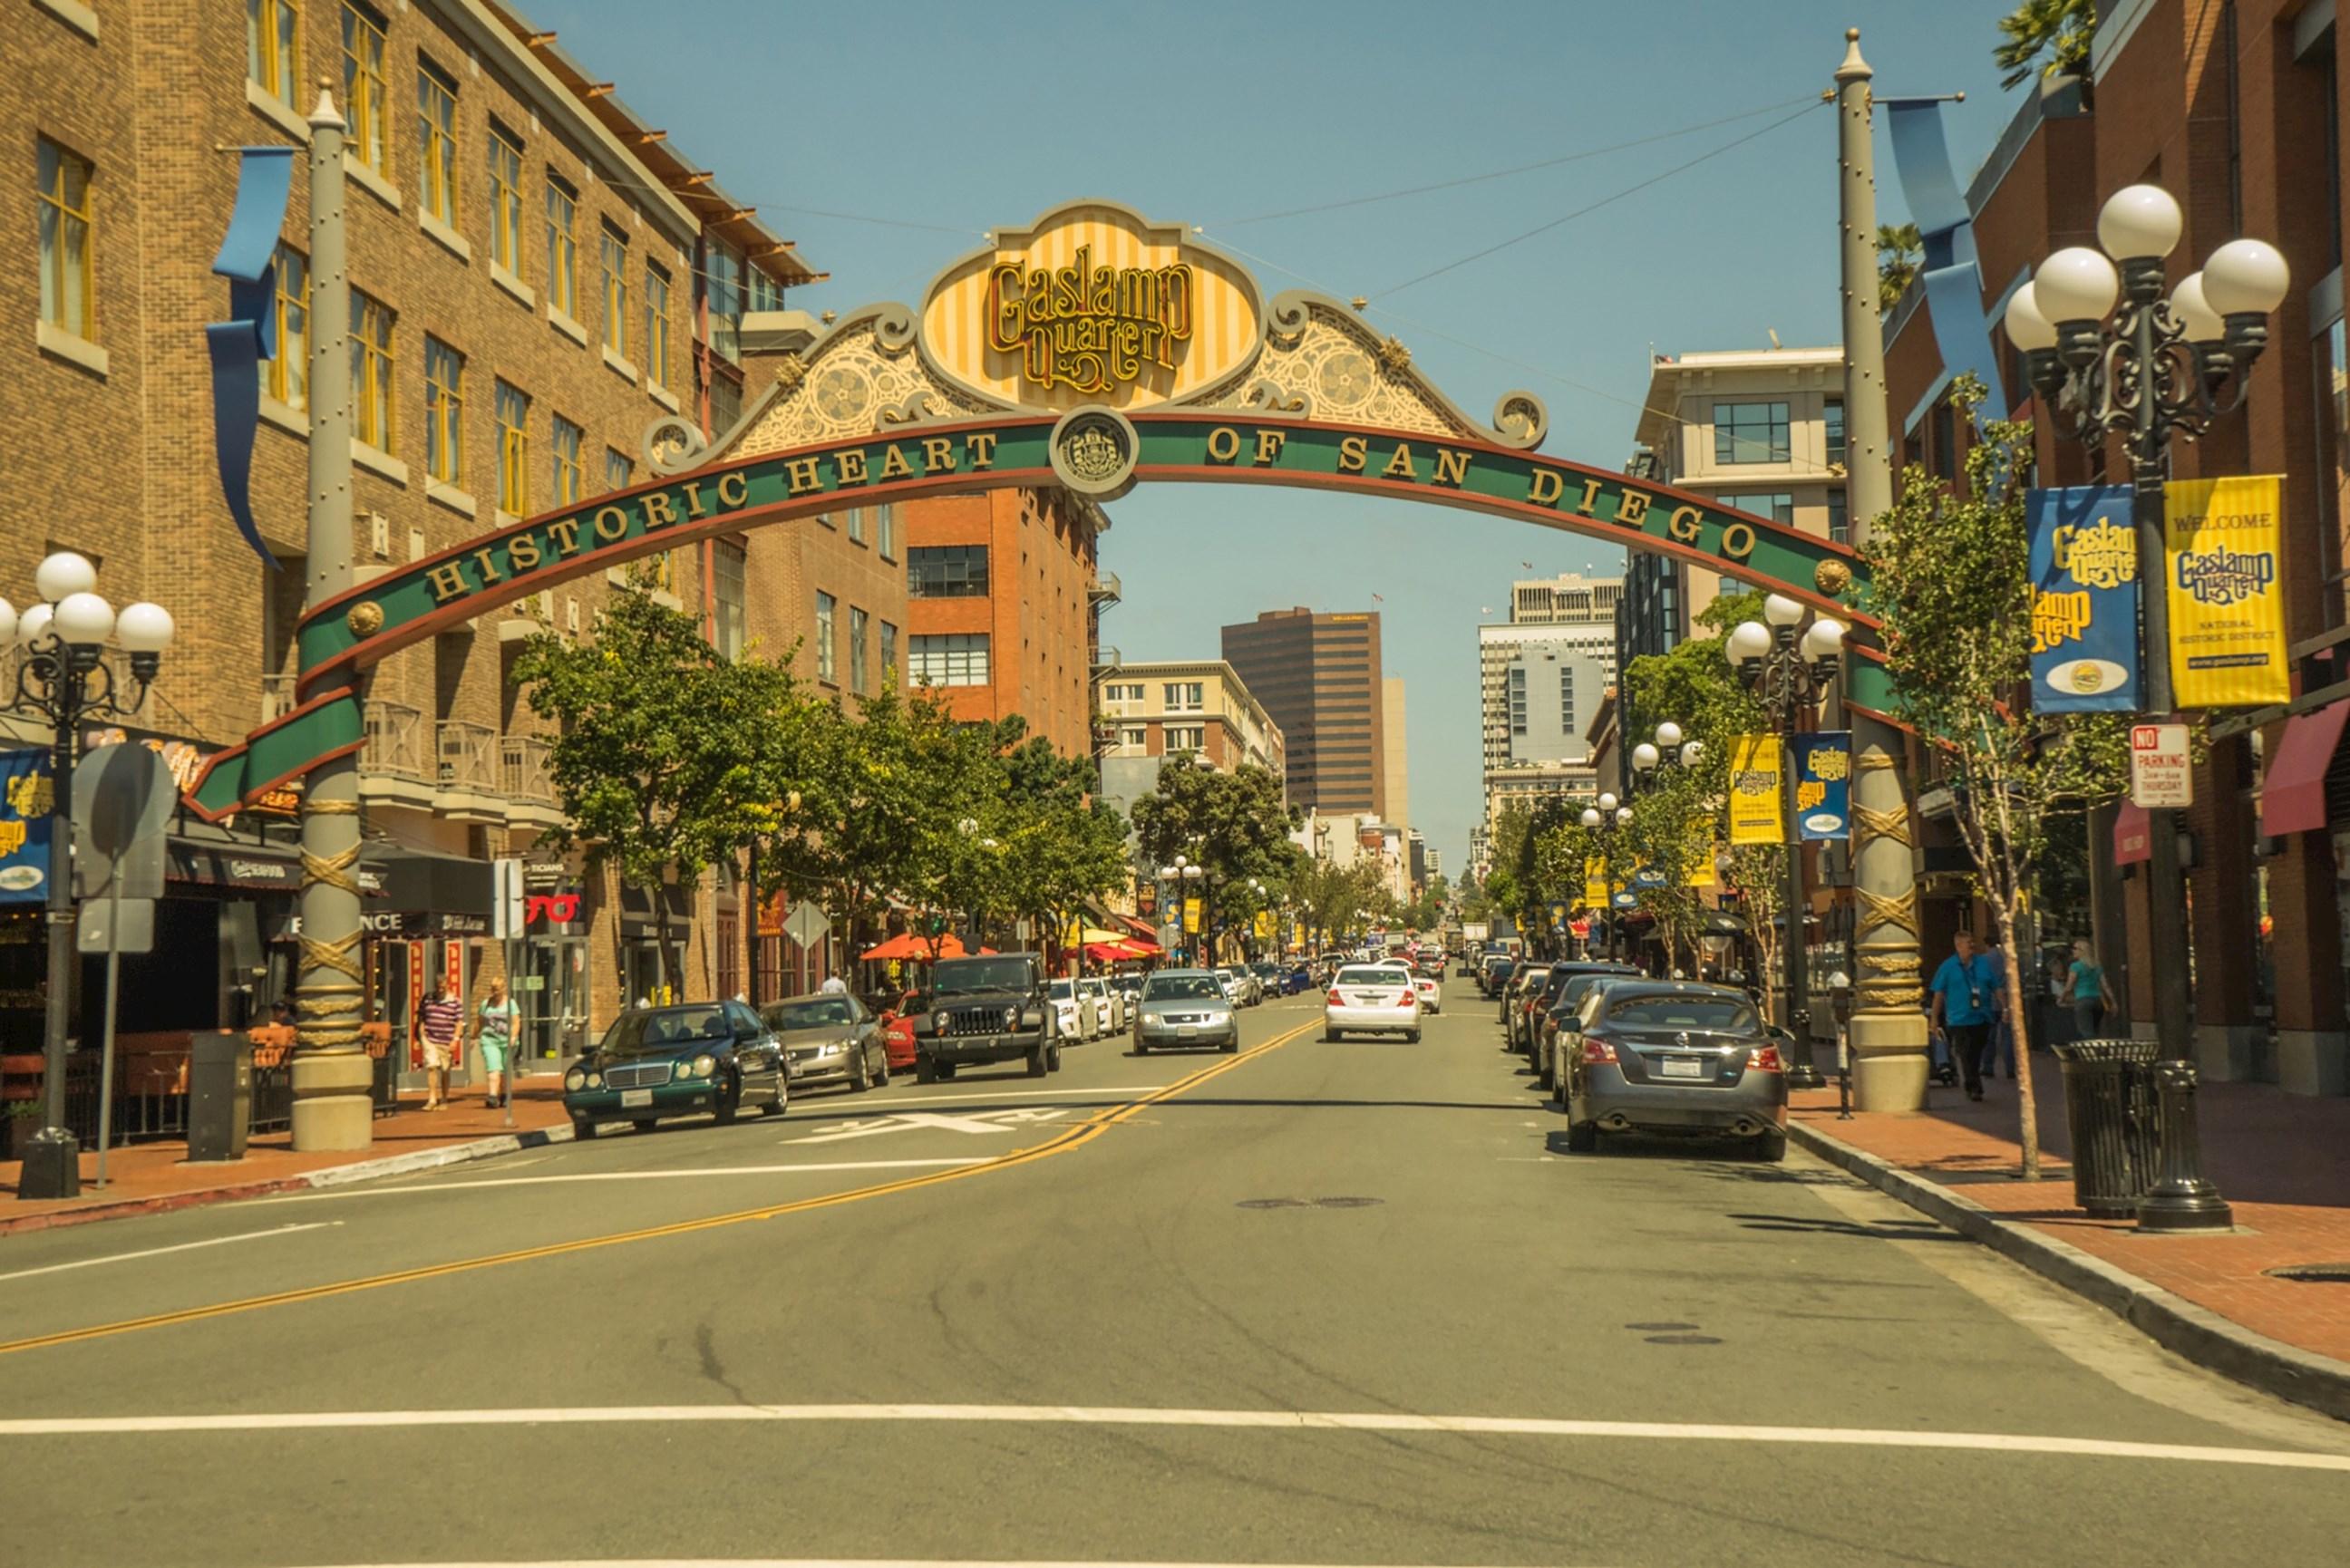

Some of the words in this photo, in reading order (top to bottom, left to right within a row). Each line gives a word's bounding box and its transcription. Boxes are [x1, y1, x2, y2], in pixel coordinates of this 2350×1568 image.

[988, 244, 1193, 370] Gaslamp
[1025, 316, 1175, 392] Quarter
[425, 472, 748, 602] HISTORIC
[785, 433, 996, 493] HEART
[1208, 428, 1286, 462] OF
[1339, 437, 1472, 484] SAN
[1528, 468, 1756, 557] DIEGO
[2174, 514, 2273, 532] WELCOME
[2178, 545, 2274, 595] Gaslamp
[2192, 575, 2266, 605] Quarter
[2135, 729, 2156, 749] NO
[2138, 754, 2185, 769] PARKING
[2141, 781, 2182, 791] THURSDAY
[525, 863, 564, 873] TICIANS
